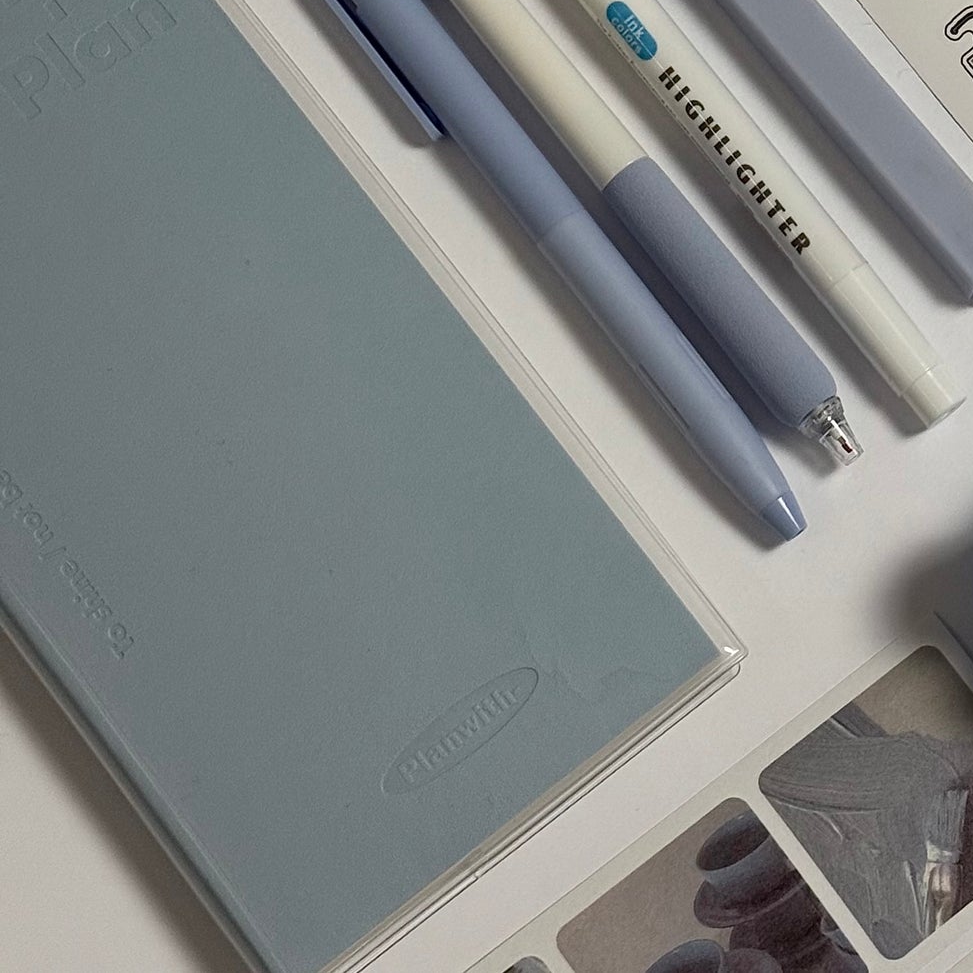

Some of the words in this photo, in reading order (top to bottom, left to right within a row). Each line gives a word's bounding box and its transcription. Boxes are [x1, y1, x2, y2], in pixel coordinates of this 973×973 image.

[611, 16, 642, 57] colors
[623, 13, 645, 40] Ink
[658, 66, 811, 255] HIGHLIGHTER
